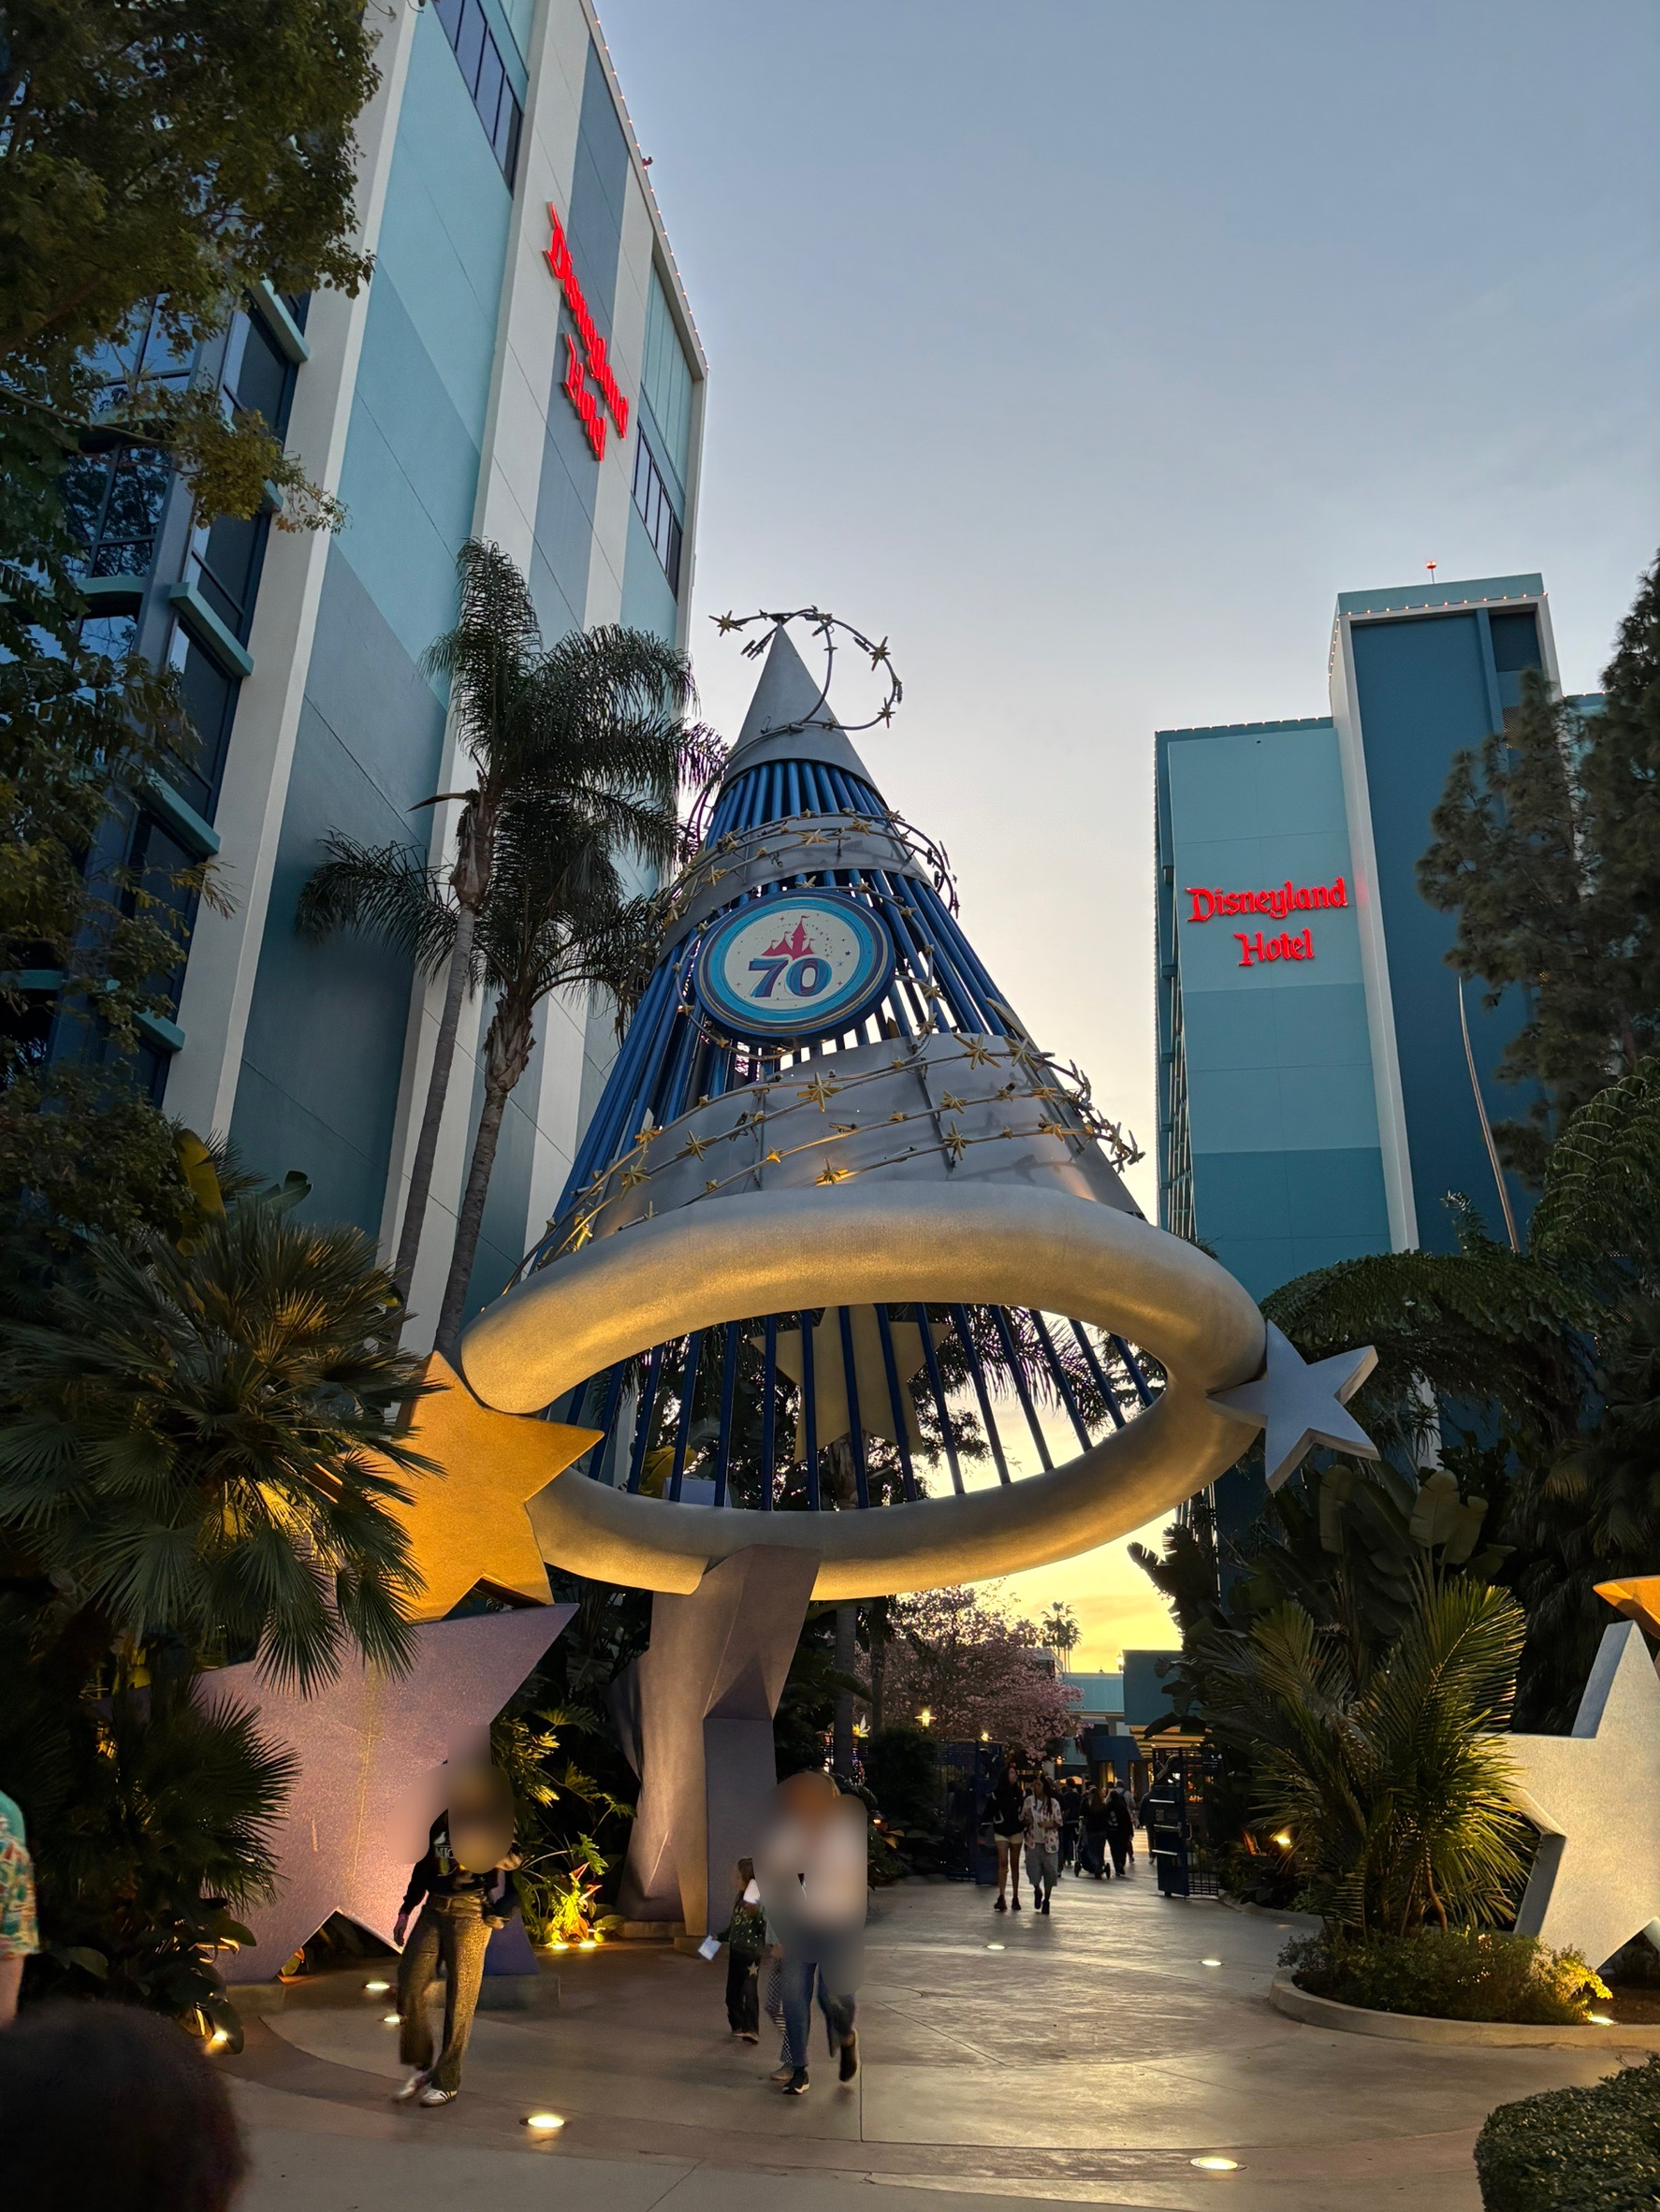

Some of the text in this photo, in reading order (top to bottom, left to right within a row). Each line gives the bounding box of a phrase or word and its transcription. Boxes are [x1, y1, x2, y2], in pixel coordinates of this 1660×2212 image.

[1185, 876, 1348, 922] Disneyland
[1232, 927, 1315, 967] Hotel
[748, 957, 833, 998] 70
